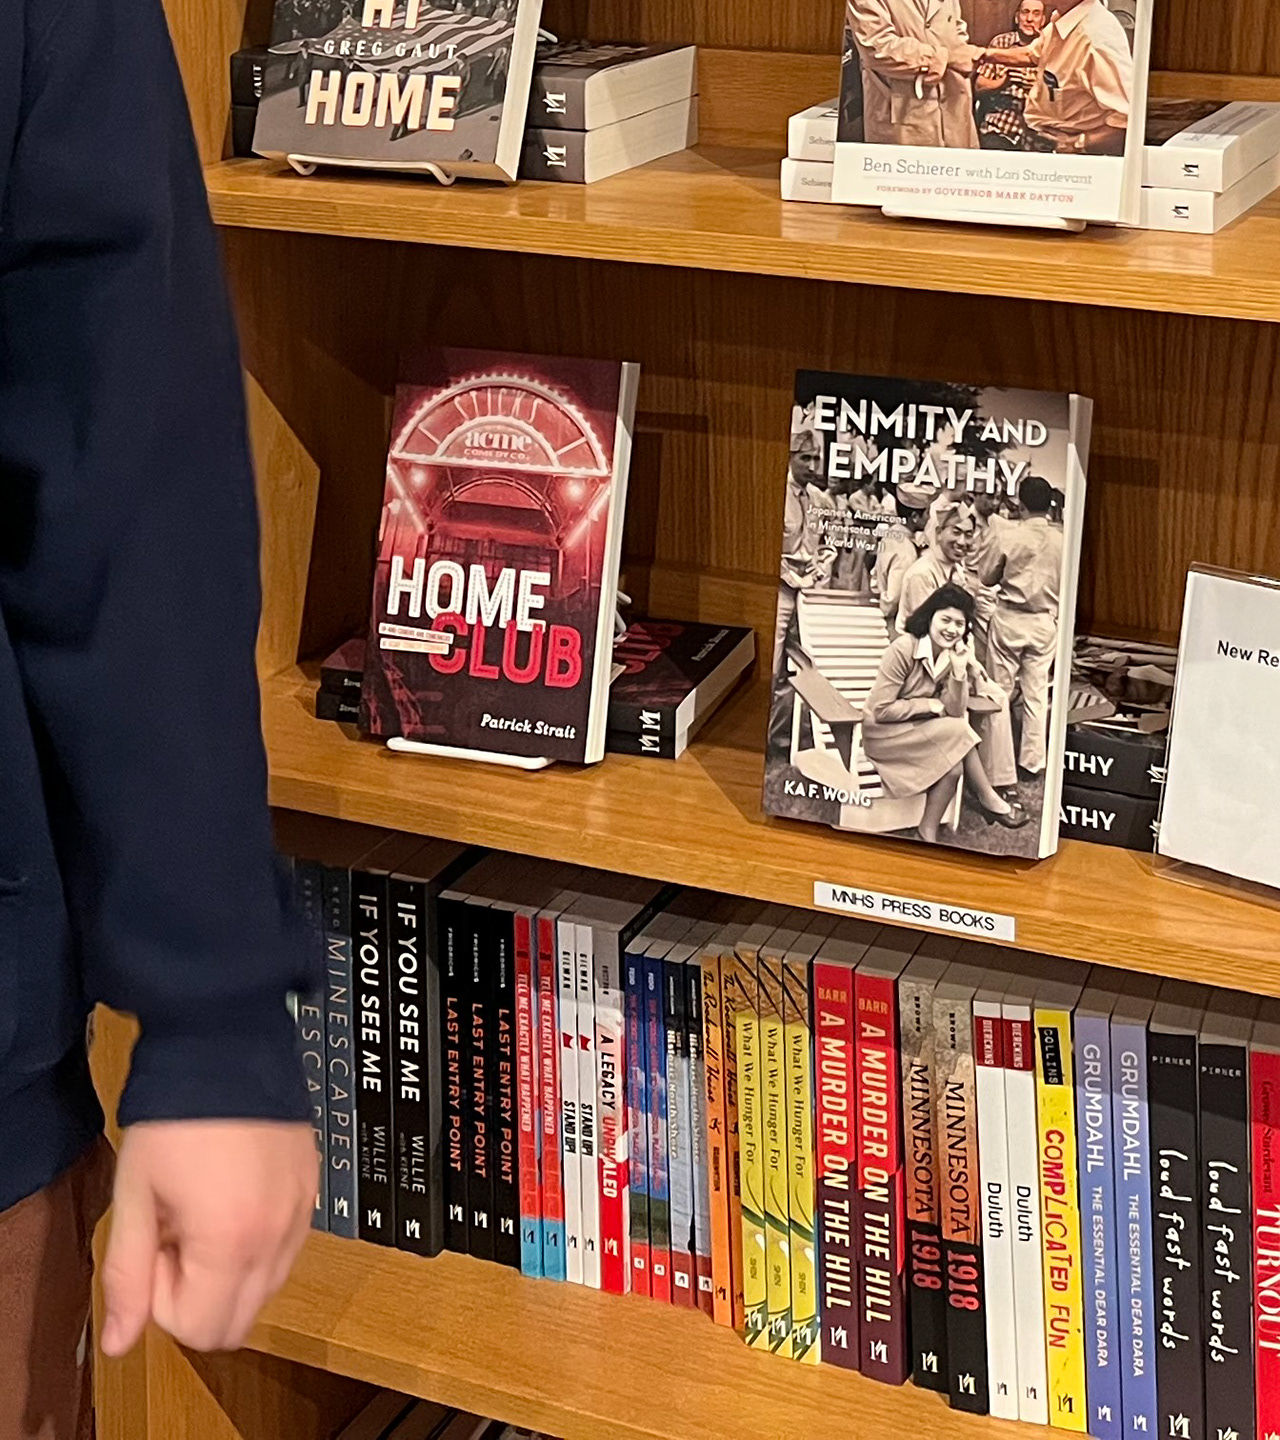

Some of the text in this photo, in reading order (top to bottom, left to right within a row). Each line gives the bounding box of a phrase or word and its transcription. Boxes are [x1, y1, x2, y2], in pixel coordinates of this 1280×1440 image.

[323, 40, 458, 60] GREG GAUT
[305, 70, 461, 131] HOME
[863, 157, 1092, 185] Ben Schierer Sturdevant
[465, 431, 532, 451] acme
[814, 395, 1047, 447] ENMITY AND
[828, 442, 1028, 496] EMPATHY
[807, 504, 906, 524] Japanese Americans
[386, 556, 551, 632] HOME
[429, 612, 582, 689] CLUB
[1217, 640, 1252, 663] New
[480, 713, 576, 739] Patrick Strait
[784, 780, 872, 807] KA F. WONG
[832, 887, 995, 932] MNHS PRESS BOOKS
[397, 901, 420, 1103] IF YOU SEE ME
[1120, 1051, 1142, 1181] GRUMDAHL
[860, 1022, 892, 1323] A MURDER ON THE HILL
[944, 1080, 980, 1312] MINNESOTA 1918
[987, 1182, 1002, 1239] Duluth
[1042, 1129, 1072, 1349] COMPLICATED FUN
[1207, 1160, 1242, 1364] loud fast words
